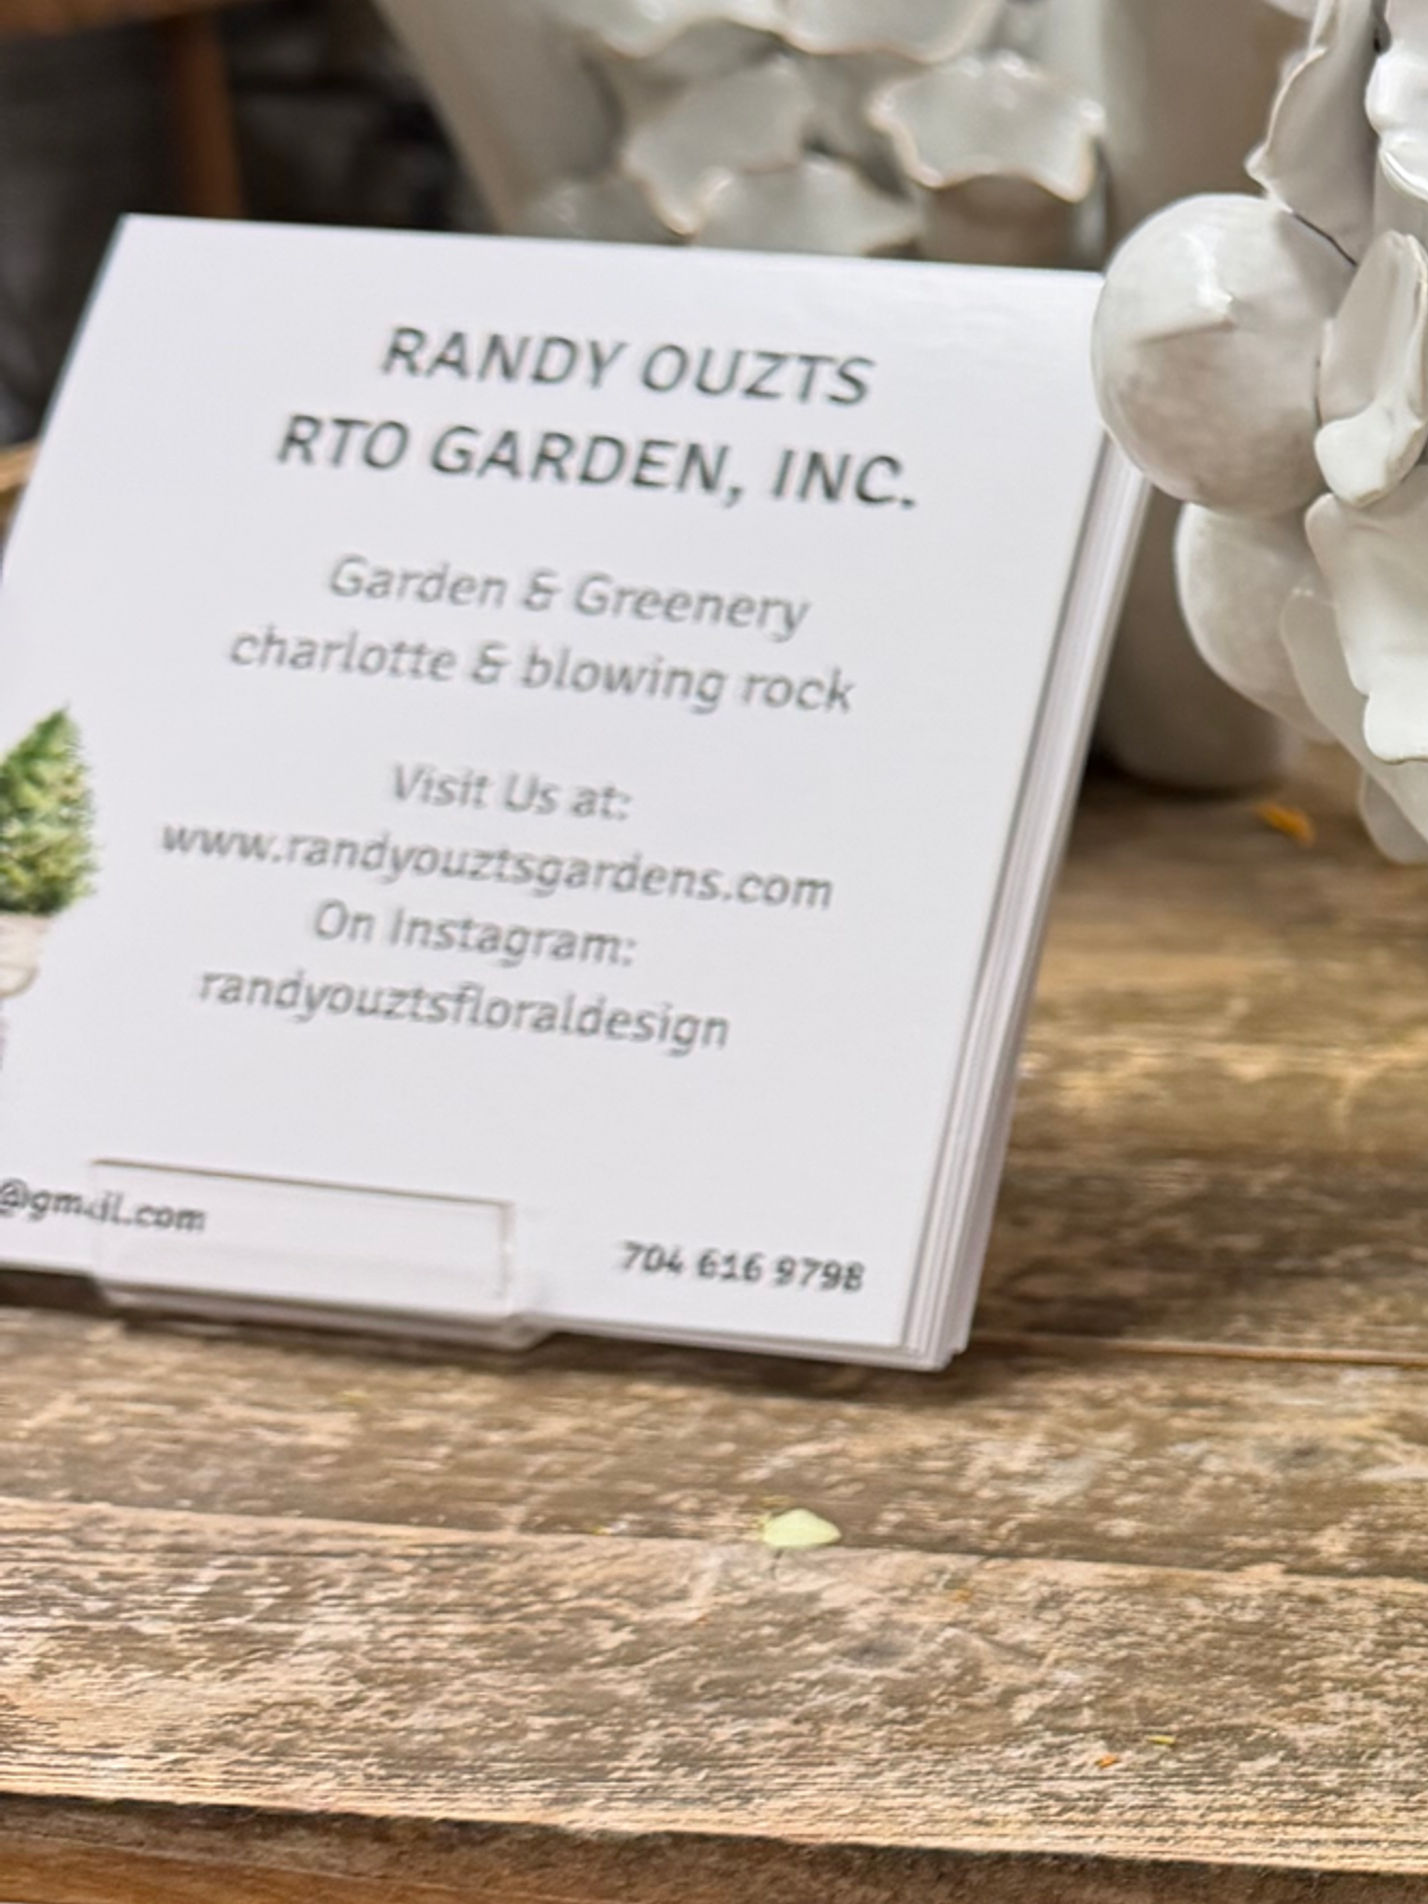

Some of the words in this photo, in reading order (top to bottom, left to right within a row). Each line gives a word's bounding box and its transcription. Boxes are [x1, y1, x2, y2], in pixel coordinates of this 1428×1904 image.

[379, 325, 627, 390] RANDY
[638, 342, 876, 408] OUZTS
[275, 412, 412, 472] RTO
[428, 423, 744, 509] GARDEN,
[769, 447, 917, 511] INC.
[328, 554, 507, 607] Garden
[521, 570, 558, 614] &
[572, 573, 810, 644] Greenery
[228, 629, 456, 683] charlotte
[469, 642, 508, 687] &
[520, 646, 727, 716] blowing
[741, 668, 855, 713] rock
[391, 763, 490, 809] Visit
[503, 773, 557, 815] Us
[569, 780, 631, 822] at:
[160, 826, 833, 908] www.randyouztsgardens.com
[313, 899, 375, 942] On
[389, 908, 640, 971] Instagram:
[198, 964, 729, 1058] randyouztsfloraldesign
[619, 1241, 685, 1276] 704
[695, 1248, 764, 1284] 616
[773, 1255, 866, 1294] 9798
